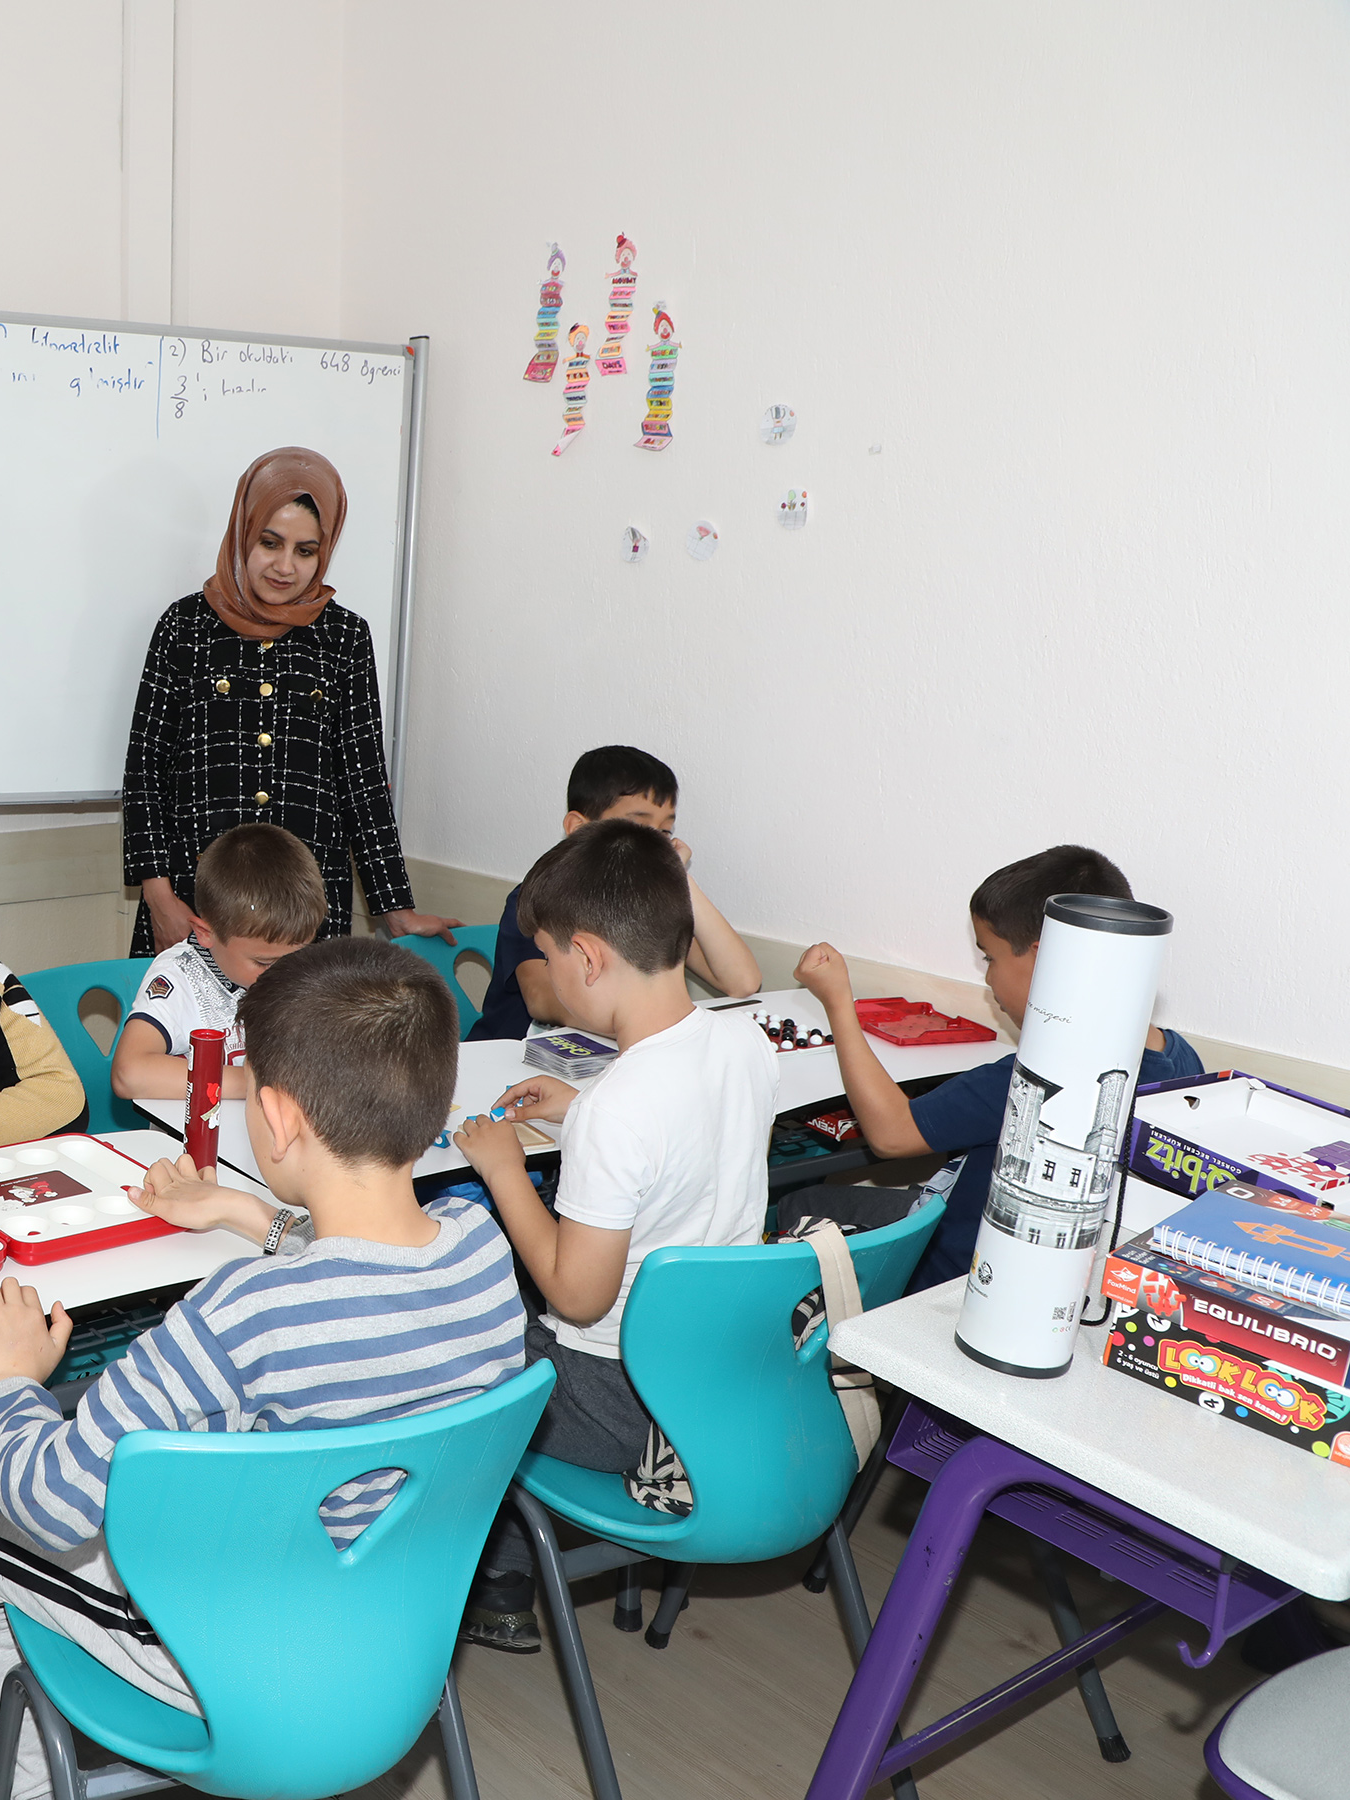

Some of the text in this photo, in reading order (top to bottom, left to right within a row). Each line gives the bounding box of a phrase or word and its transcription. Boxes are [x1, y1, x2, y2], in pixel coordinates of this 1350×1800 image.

[201, 339, 228, 364] Bir
[320, 352, 350, 373] 648
[1107, 1279, 1137, 1294] FoxMind
[1193, 1298, 1337, 1360] EQUILIBRIO
[1122, 1360, 1134, 1370] yaş
[1135, 1365, 1144, 1373] ve
[1144, 1369, 1160, 1380] üstü
[1134, 1357, 1159, 1372] oyuncu
[1182, 1373, 1217, 1390] Dikkatli
[1237, 1393, 1254, 1405] sen
[1254, 1400, 1288, 1423] kazan!
